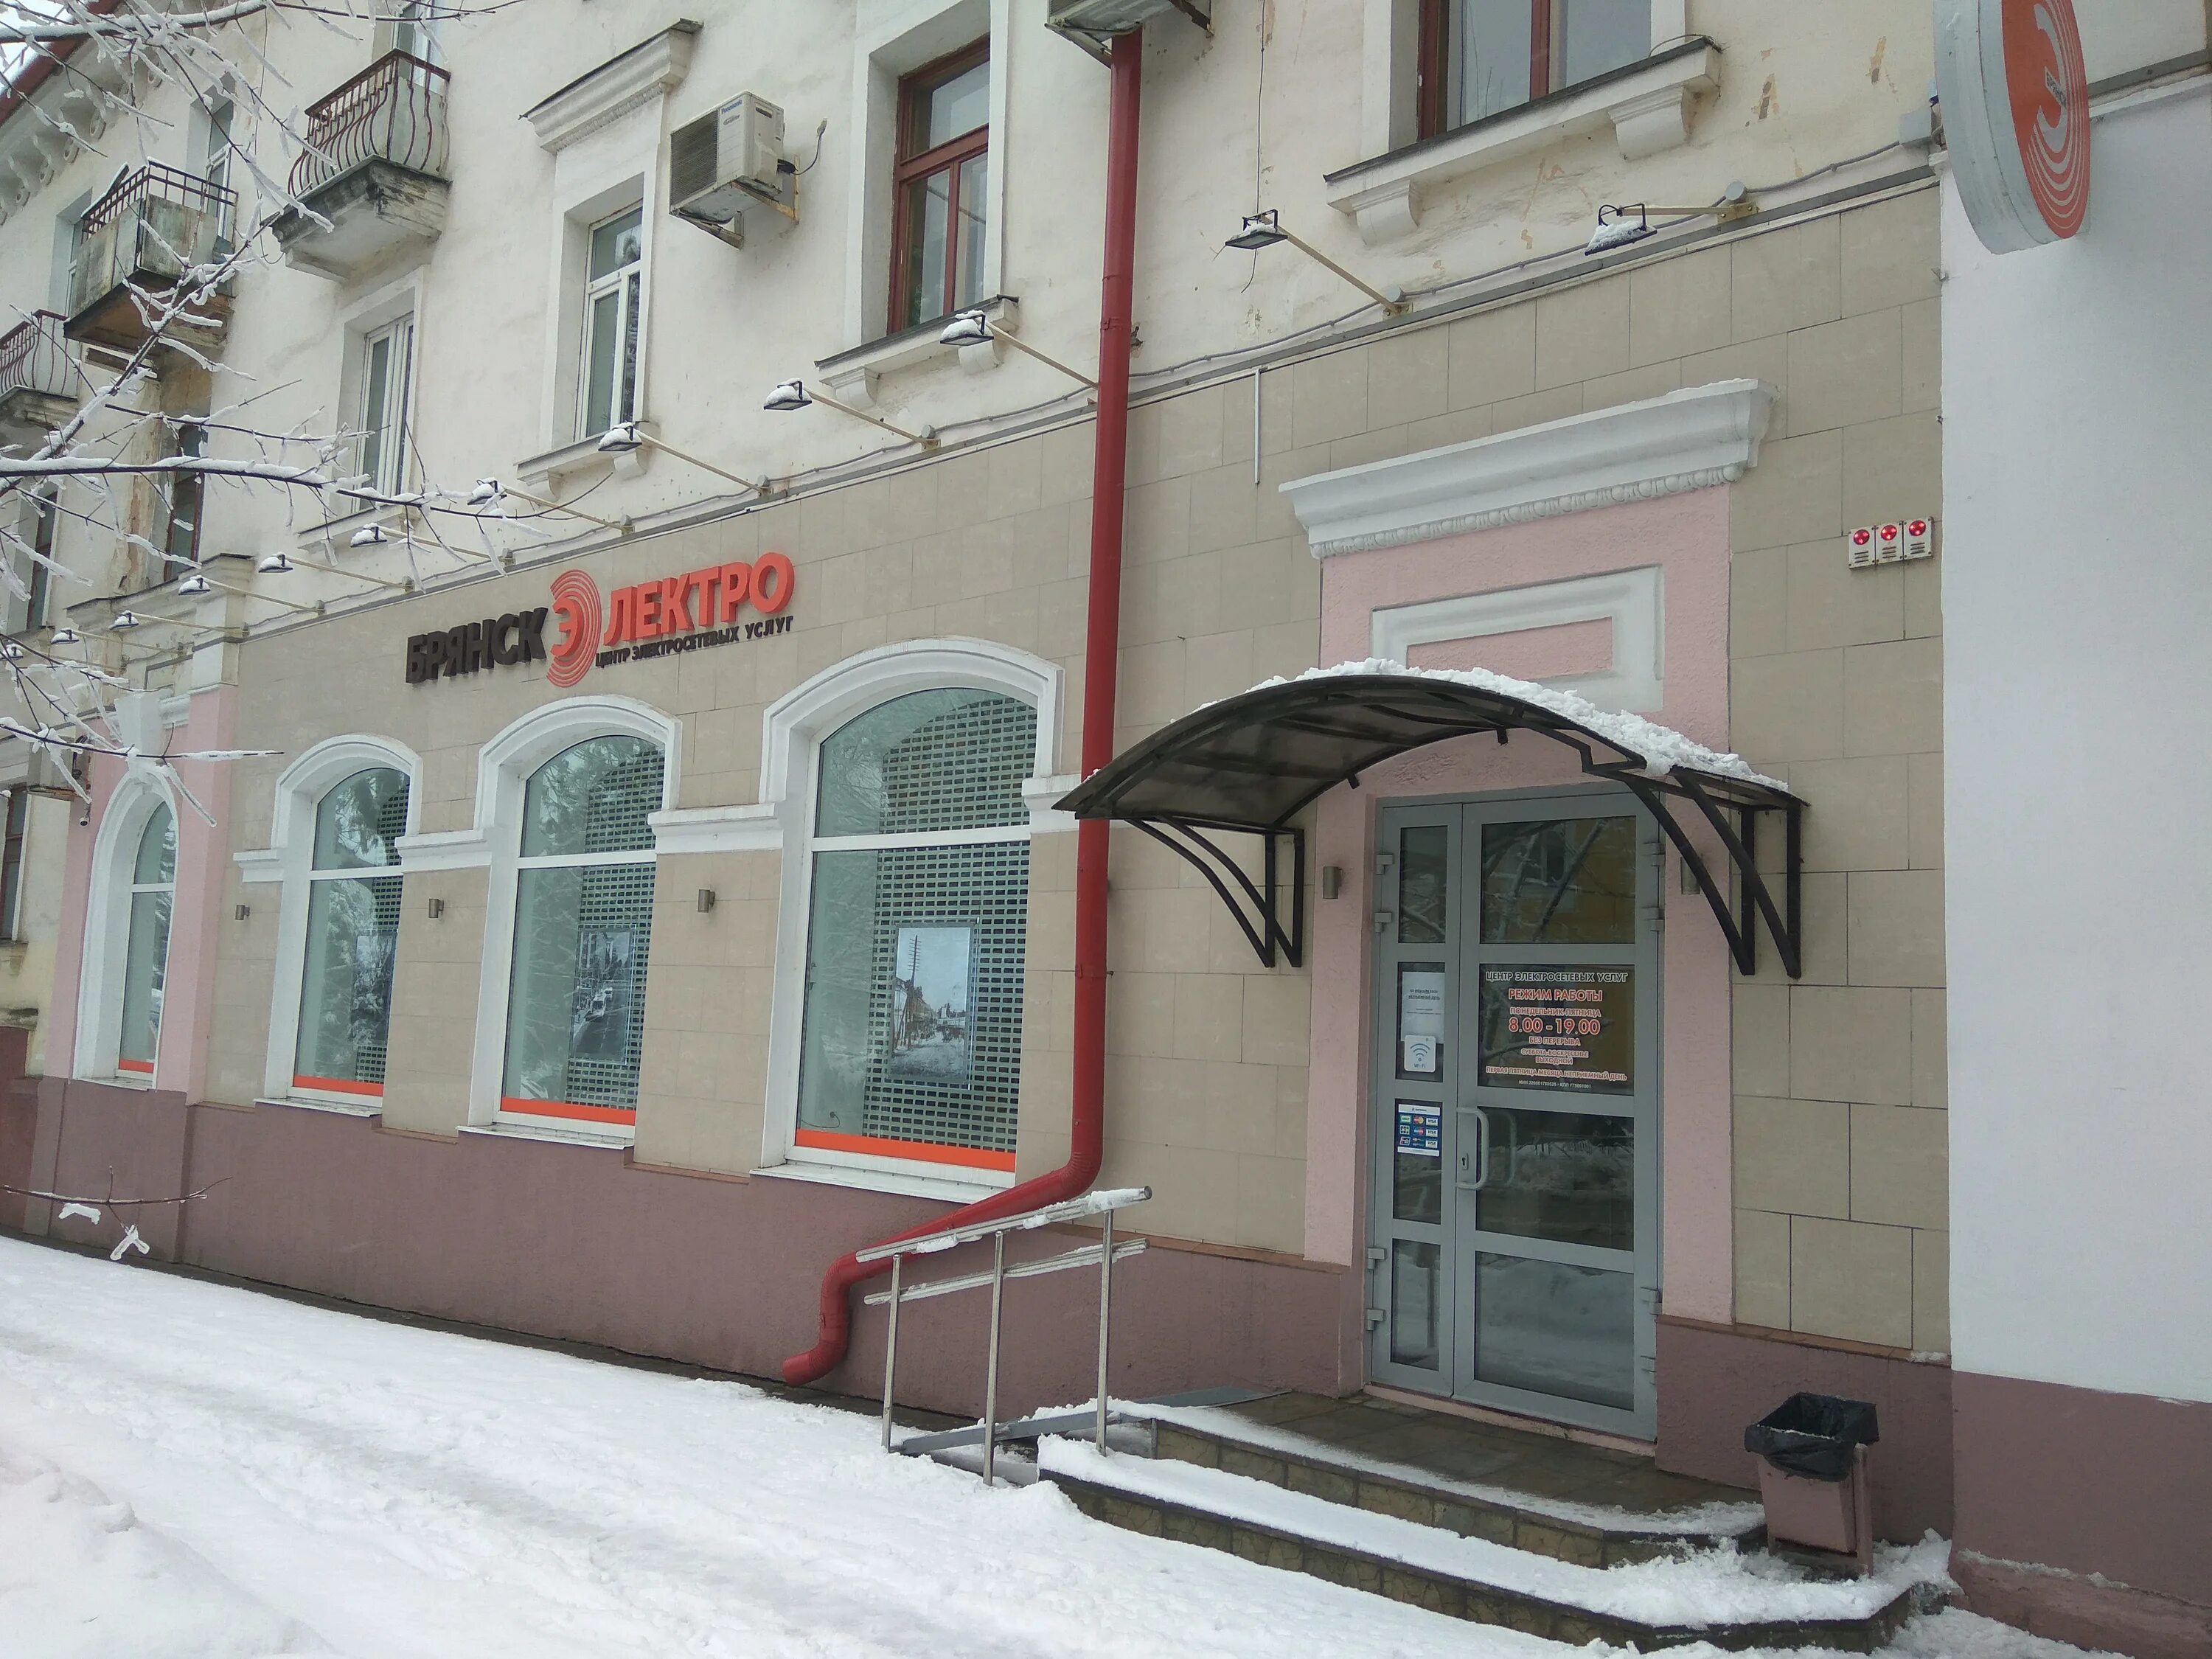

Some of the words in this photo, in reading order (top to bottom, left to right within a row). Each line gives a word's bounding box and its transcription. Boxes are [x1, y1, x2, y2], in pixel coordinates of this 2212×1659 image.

[721, 99, 742, 114] Panasonic
[596, 647, 630, 668] ЦЕНТР
[632, 626, 740, 660] ЭЛЕКТРОСЕТЕВЫХ
[745, 616, 793, 639] УСЛУГ
[1486, 972, 1513, 981] ЦЕНТР
[1515, 972, 1595, 982] ЭЛЕКТРОСЕТЕВЫХ
[1598, 973, 1628, 983] УСЛУГ
[1509, 989, 1551, 1001] РЕЖИМ
[1554, 990, 1603, 1001] РАБОТЫ
[1509, 1017, 1543, 1033] 8.00
[1555, 1018, 1601, 1035] 19.00
[1528, 1036, 1543, 1044] БЕЗ
[1543, 1037, 1581, 1046] ПЕРЕРЫВА
[1536, 1056, 1573, 1065] ВЫХОДНОЙ
[1509, 1068, 1537, 1076] ПЯТНИЦА
[1538, 1069, 1563, 1077] МЕСЯЦА
[1564, 1070, 1609, 1079] НЕПРИЕМНЫЙ
[1610, 1073, 1627, 1081] ДЕНЬ
